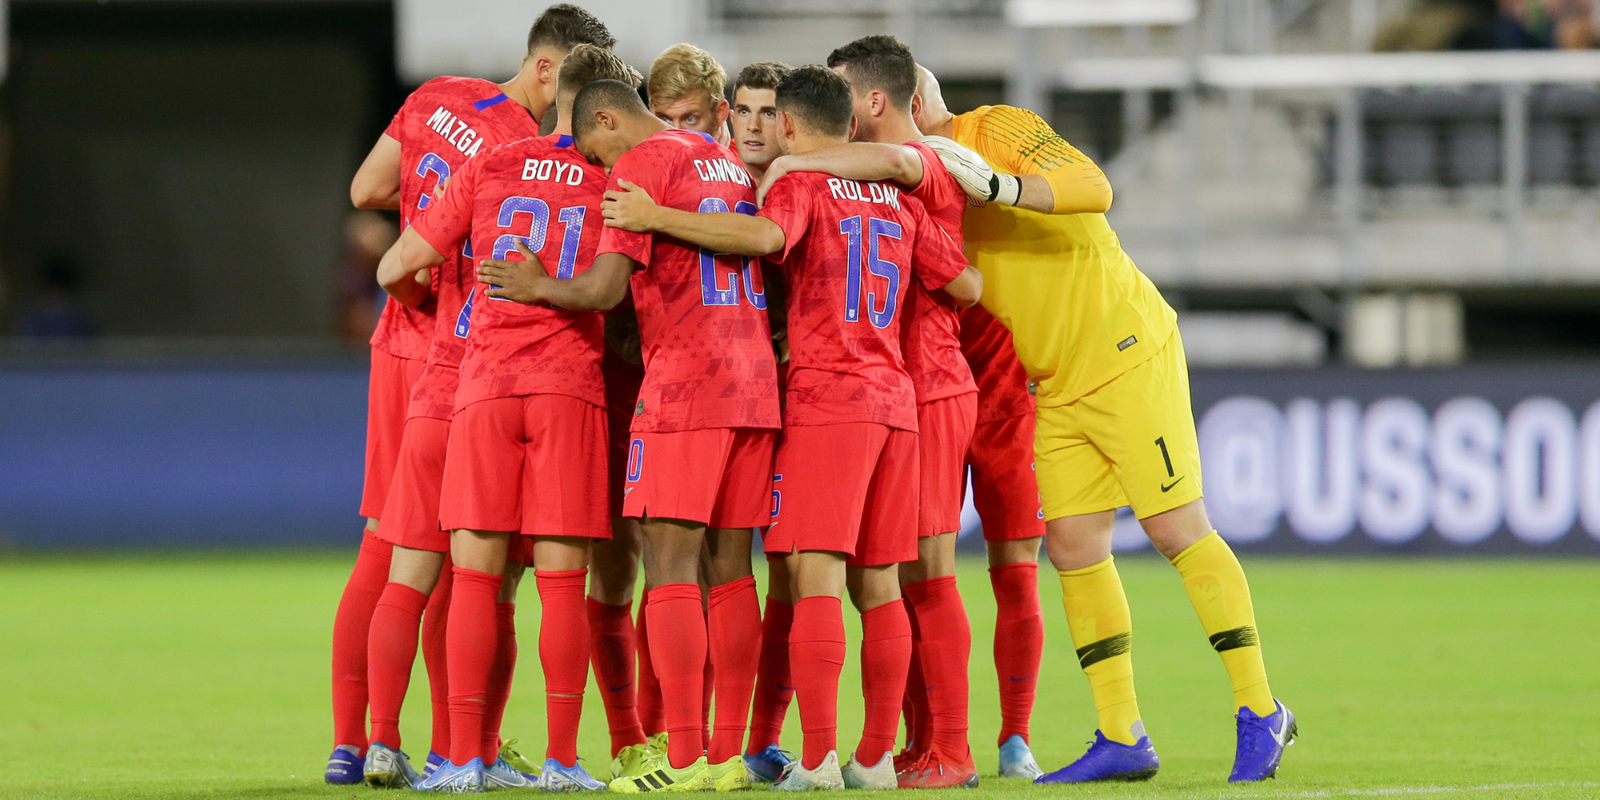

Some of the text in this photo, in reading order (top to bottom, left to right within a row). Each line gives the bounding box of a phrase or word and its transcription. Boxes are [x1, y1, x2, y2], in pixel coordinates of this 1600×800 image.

[426, 106, 484, 159] MIAZGA
[521, 158, 585, 187] BOYD
[693, 158, 752, 188] CANNON
[826, 177, 901, 211] ROLDAN
[489, 196, 587, 309] 21
[840, 215, 902, 329] 15
[1154, 436, 1175, 478] 1
